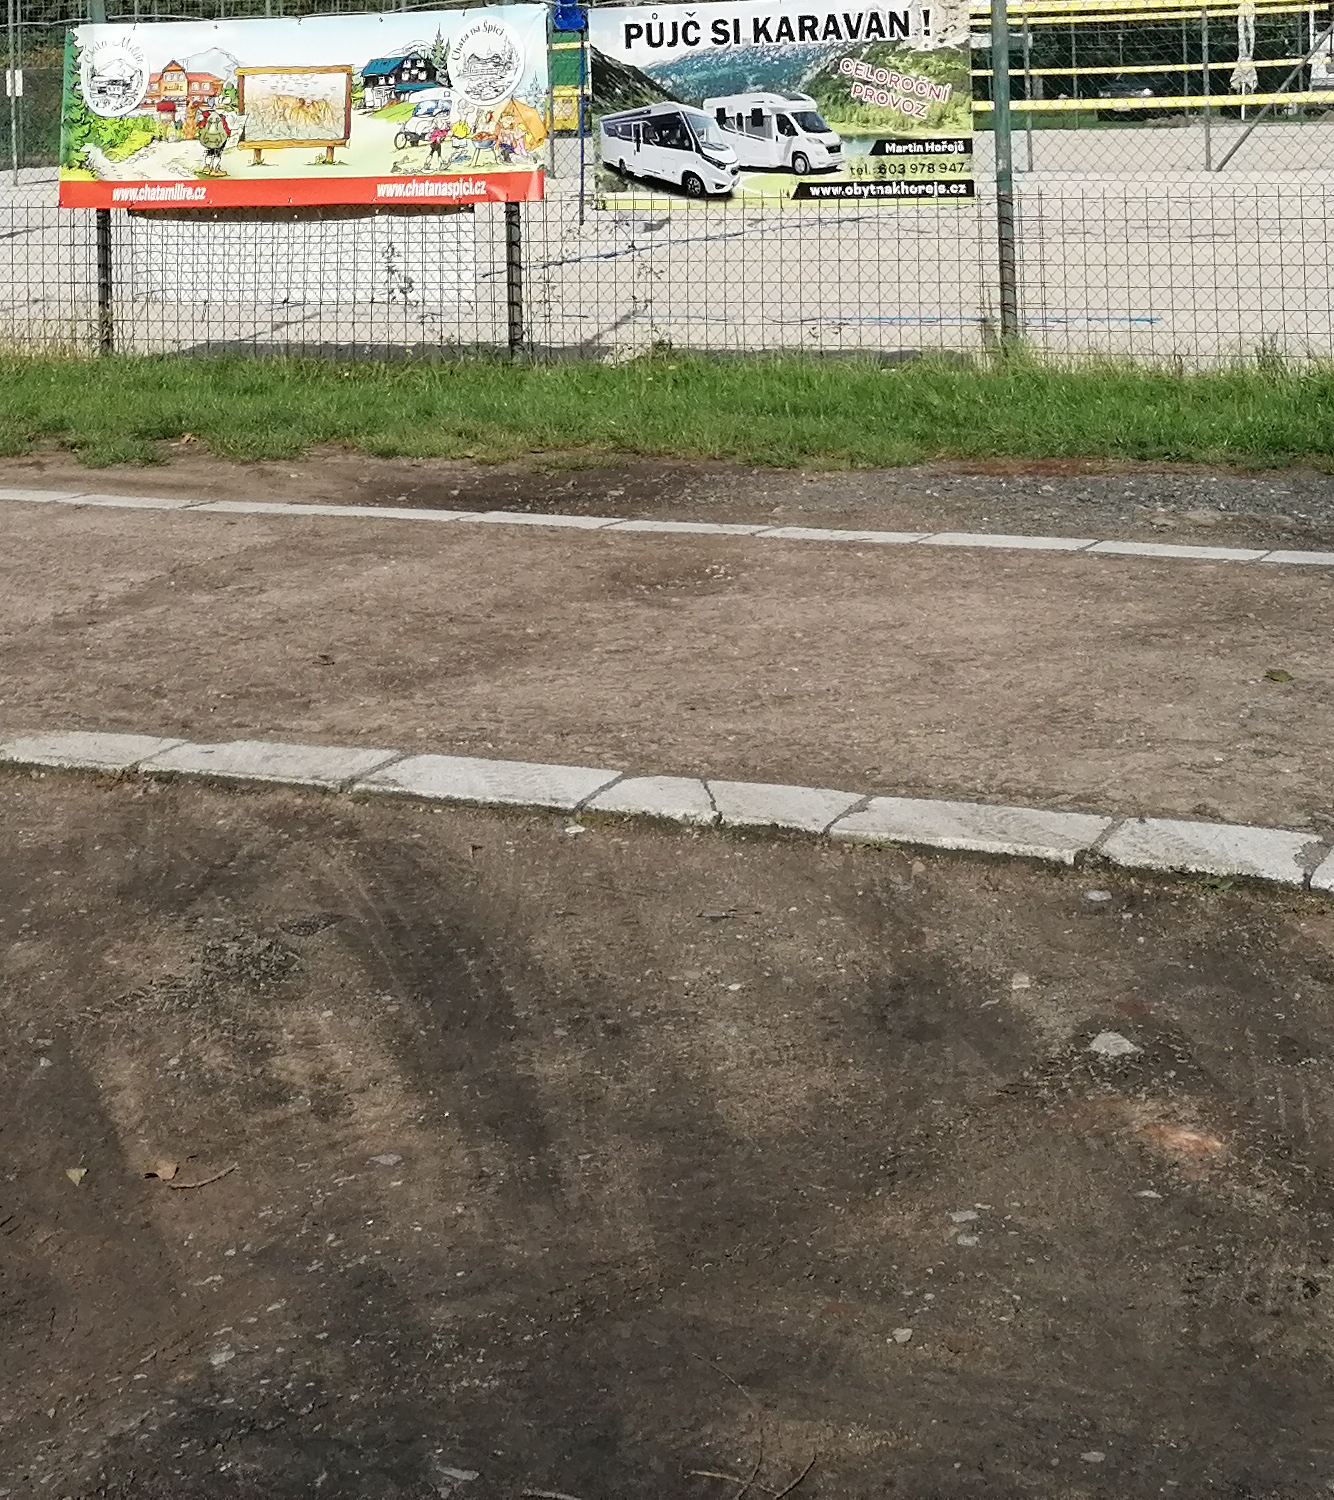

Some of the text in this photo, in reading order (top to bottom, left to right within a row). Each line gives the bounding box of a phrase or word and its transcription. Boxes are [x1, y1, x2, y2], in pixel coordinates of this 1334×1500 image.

[623, 11, 700, 49] PŮJČ
[710, 17, 741, 45] SI
[753, 9, 910, 45] KARAVAN
[840, 58, 951, 102] CELOROČNÍ
[851, 82, 928, 119] PROVOZ
[885, 141, 924, 154] Martin
[910, 163, 936, 175] 978
[939, 162, 966, 174] 947
[376, 176, 487, 201] www.chatanaspici.cz
[809, 181, 967, 199] www.obytnakhorejs.cz
